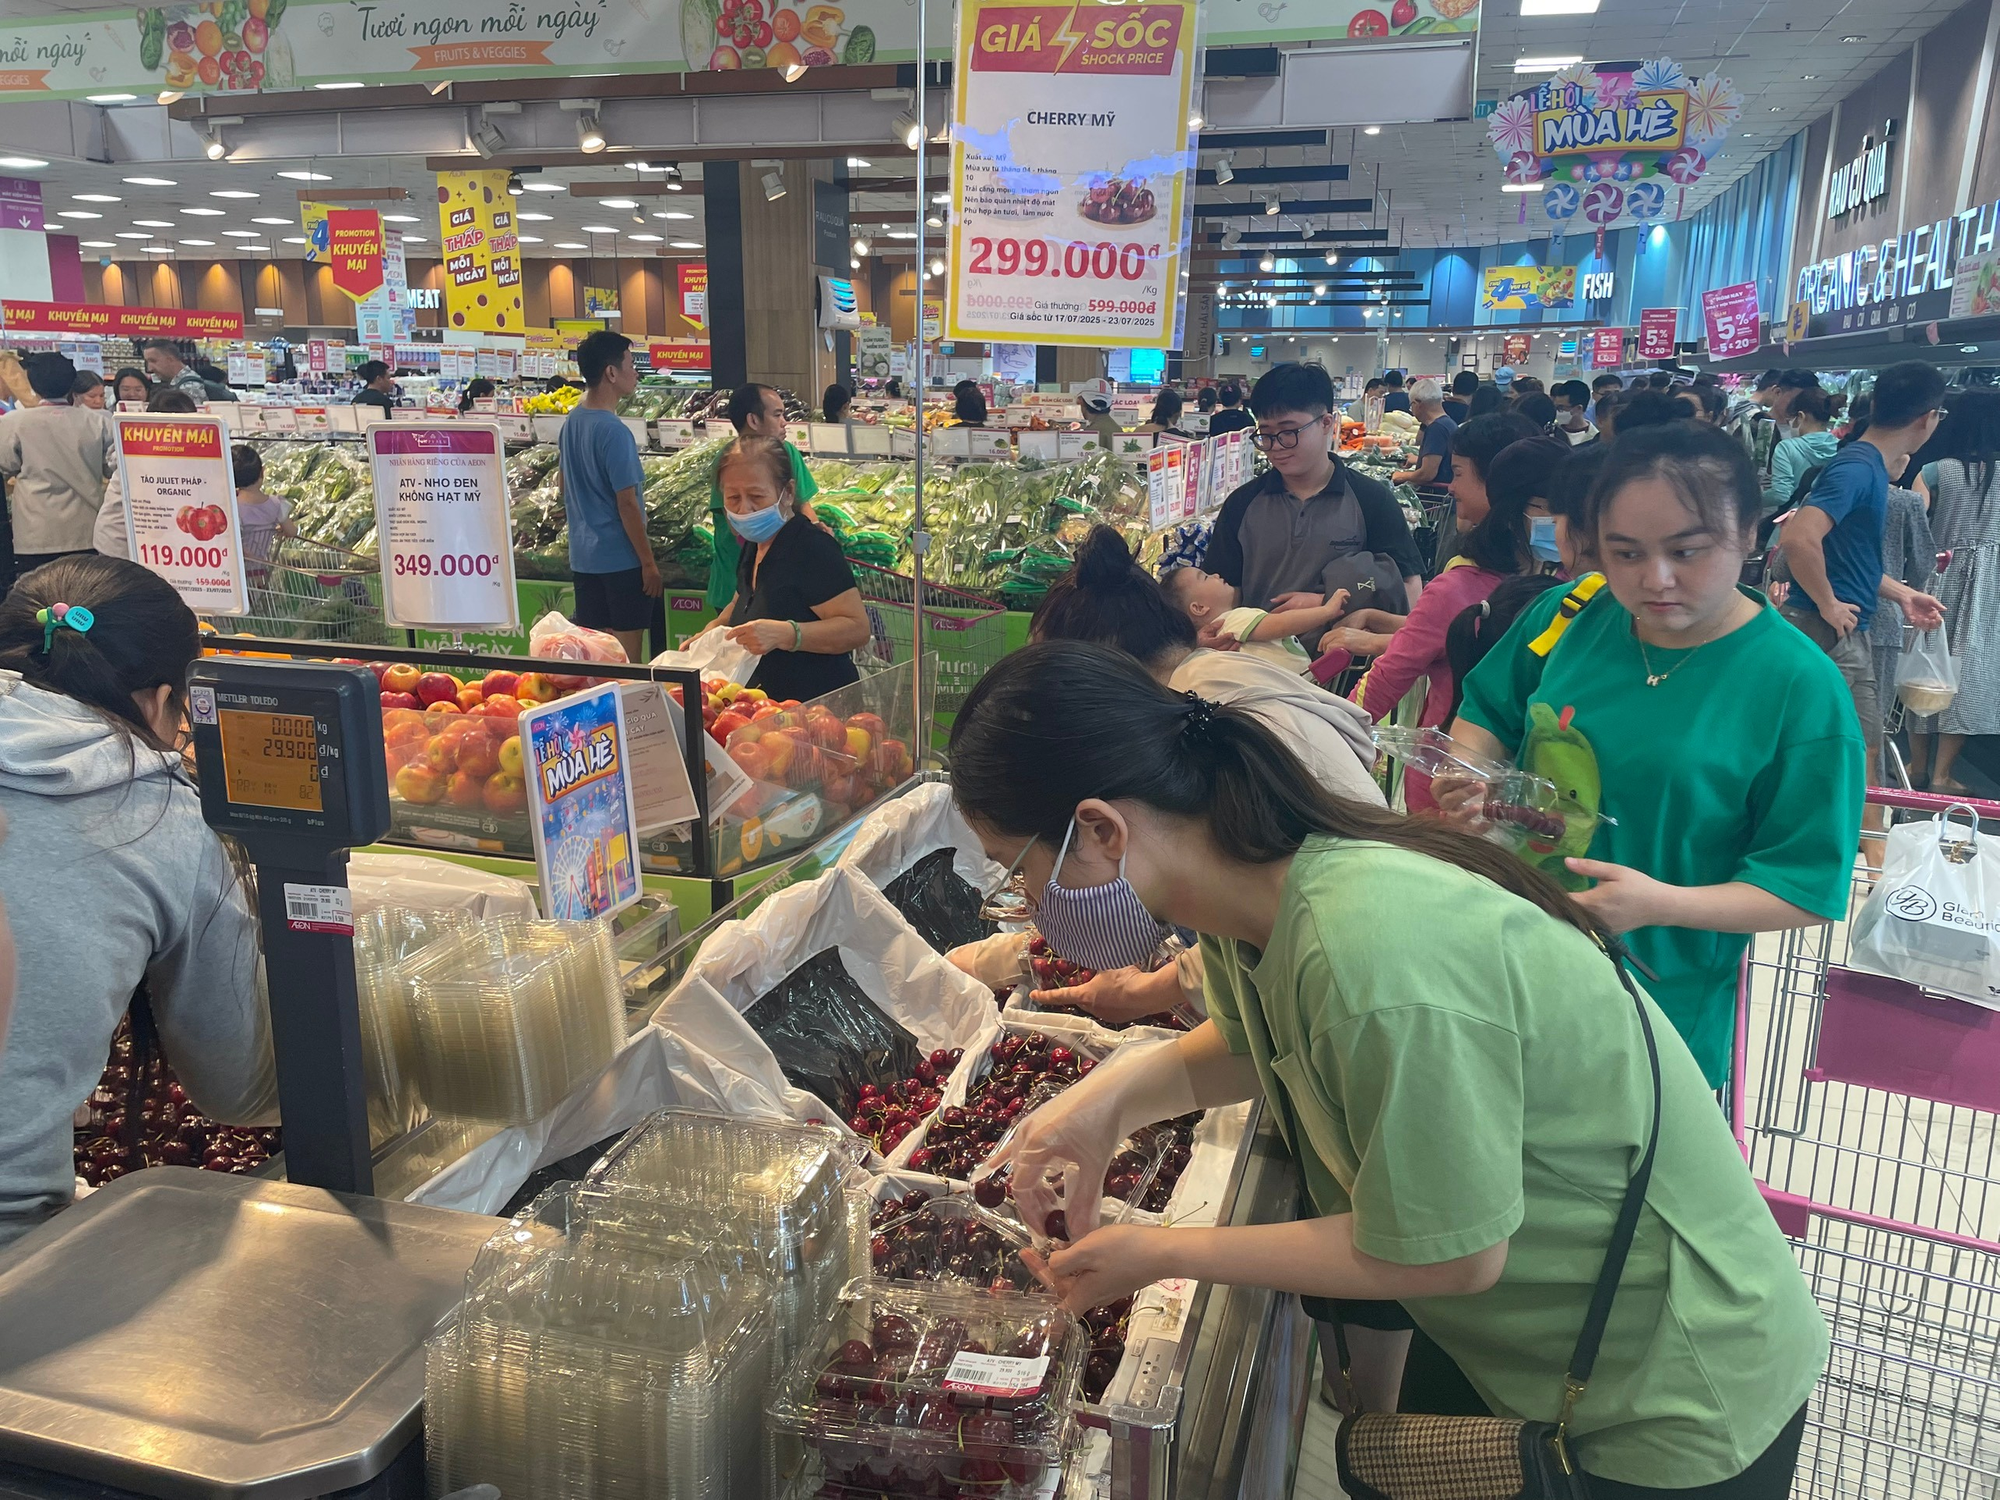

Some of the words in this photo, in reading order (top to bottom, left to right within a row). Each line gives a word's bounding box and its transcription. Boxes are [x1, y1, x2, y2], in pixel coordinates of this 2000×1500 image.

[358, 7, 406, 41] Tươi
[413, 18, 473, 45] ngon
[481, 3, 527, 34] mỗi
[537, 1, 601, 39] ngày
[980, 16, 1042, 53] GIÁ
[1091, 7, 1172, 50] SỐC
[37, 35, 86, 67] ngày
[434, 48, 471, 63] FRUITS
[473, 48, 481, 59] &
[482, 46, 527, 60] VEGGIES
[1081, 53, 1124, 65] SHOCK
[1127, 53, 1164, 64] PRICE
[1530, 83, 1551, 112] LỄ
[1550, 83, 1582, 111] HỘI
[1027, 111, 1086, 126] CHERRY
[1091, 111, 1116, 127] MỸ
[1543, 105, 1620, 152] MÙA
[1625, 99, 1678, 141] HÈ
[1828, 163, 1850, 219] RAU
[1849, 135, 1867, 209] CỦ
[452, 209, 471, 224] GIÁ
[495, 213, 509, 225] GIÁ
[444, 226, 485, 252] THẤP
[489, 231, 518, 252] THẤP
[333, 240, 378, 255] KHUYẾN
[450, 254, 470, 271] MỖI
[493, 256, 509, 272] MỖI
[1796, 245, 1870, 315] ORGANIC
[1873, 238, 1890, 303] &
[1891, 199, 2000, 300] HEALTH
[347, 259, 367, 273] MẠI
[456, 267, 485, 283] NGÀY
[498, 271, 519, 285] NGÀY
[1142, 285, 1158, 296] /Kg
[1491, 278, 1514, 301] 4
[1582, 272, 1614, 299] FISH
[407, 289, 440, 309] MEAT
[1035, 301, 1049, 310] Giá
[1088, 299, 1156, 314] 599.000đ
[16, 309, 35, 321] MẠI
[48, 308, 88, 322] KHUYẾN
[91, 312, 109, 325] MẠI
[120, 312, 158, 326] KHUYẾN
[160, 315, 176, 327] MẠI
[187, 315, 221, 329] KHUYẾN
[223, 318, 238, 330] MẠI
[1010, 311, 1024, 320] Giá
[1026, 311, 1041, 321] sốc
[1044, 313, 1053, 321] từ
[1055, 312, 1101, 324] 17/07/2025
[1108, 315, 1155, 326] 23/07/2025
[1720, 343, 1728, 353] 5
[1735, 338, 1749, 349] 20
[657, 349, 688, 358] KHUYẾN
[689, 351, 704, 361] MẠI
[124, 423, 185, 443] KHUYẾN
[186, 428, 213, 448] MẠI
[152, 445, 185, 453] PROMOTION
[408, 458, 425, 466] HÀNG
[427, 457, 449, 466] RIÊNG
[451, 457, 466, 466] CỦA
[141, 475, 154, 484] TÁO
[156, 476, 179, 485] JULIET
[181, 475, 202, 485] PHÁP
[400, 478, 416, 488] ATV
[424, 478, 450, 488] NHO
[453, 478, 478, 488] ĐEN
[156, 488, 191, 496] ORGANIC
[399, 491, 434, 502] KHÔNG
[437, 492, 459, 504] HẠT
[464, 489, 481, 502] MỸ
[141, 543, 228, 568] 119.000đ
[394, 553, 499, 576] 349.000đ
[196, 578, 230, 587] 159.000đ
[673, 599, 700, 610] AEON
[217, 693, 248, 703] METTLER
[250, 695, 278, 706] TOLEDO
[317, 722, 328, 734] kg
[535, 737, 548, 765] LỄ
[547, 732, 565, 760] HỘI
[546, 750, 588, 797] MÙA
[590, 733, 615, 770] HÈ
[310, 764, 318, 782] 0
[291, 921, 311, 930] AEON
[946, 1383, 974, 1391] AEON
